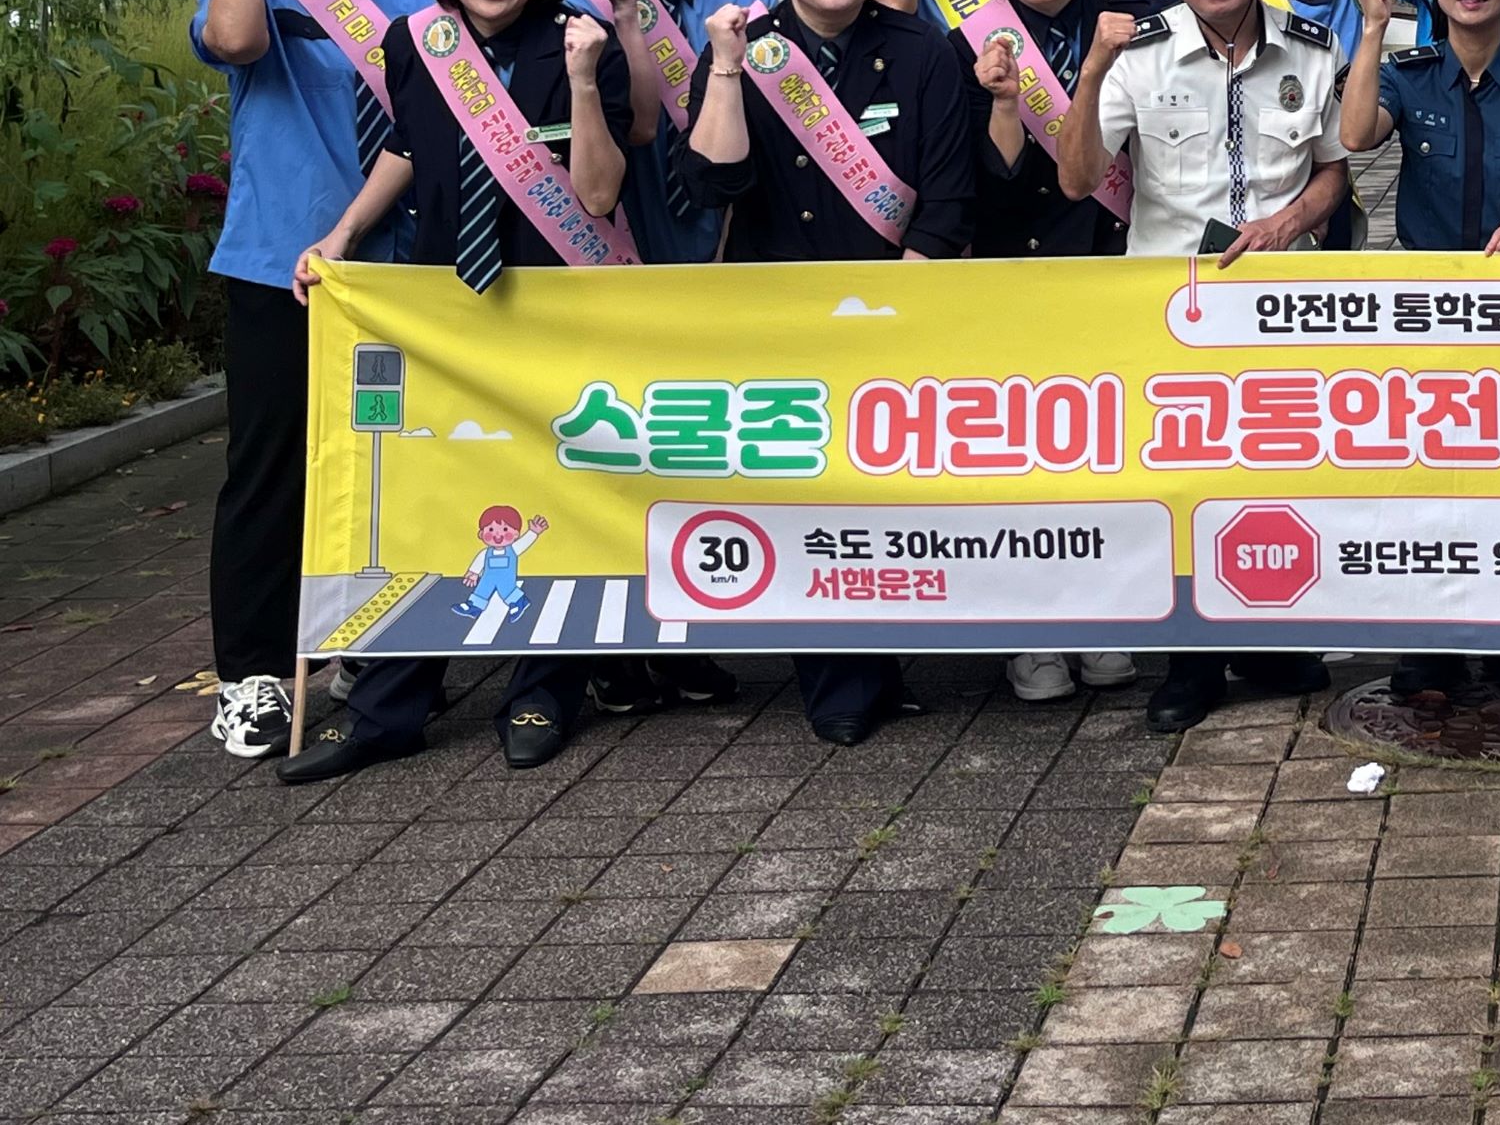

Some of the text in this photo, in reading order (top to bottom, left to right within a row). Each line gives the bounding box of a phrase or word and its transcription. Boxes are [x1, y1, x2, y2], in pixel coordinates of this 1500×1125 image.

[649, 36, 690, 87] 교문
[449, 58, 496, 118] 운전자의
[481, 110, 522, 156] 세심한
[505, 149, 545, 184] 배려
[527, 176, 571, 219] 안전한
[778, 74, 830, 130] 운전자의
[815, 121, 857, 164] 세심한
[842, 158, 878, 191] 배려
[1255, 293, 1381, 333] 안전한
[558, 386, 823, 472] 스쿨존
[852, 383, 1116, 471] 어린이
[698, 536, 750, 571] 30
[803, 528, 1104, 561] 속도 30km/h이하
[1236, 543, 1299, 569] STOP
[1338, 539, 1480, 576] 횡단보도
[710, 574, 739, 585] km/h
[806, 568, 947, 600] 서행운전
